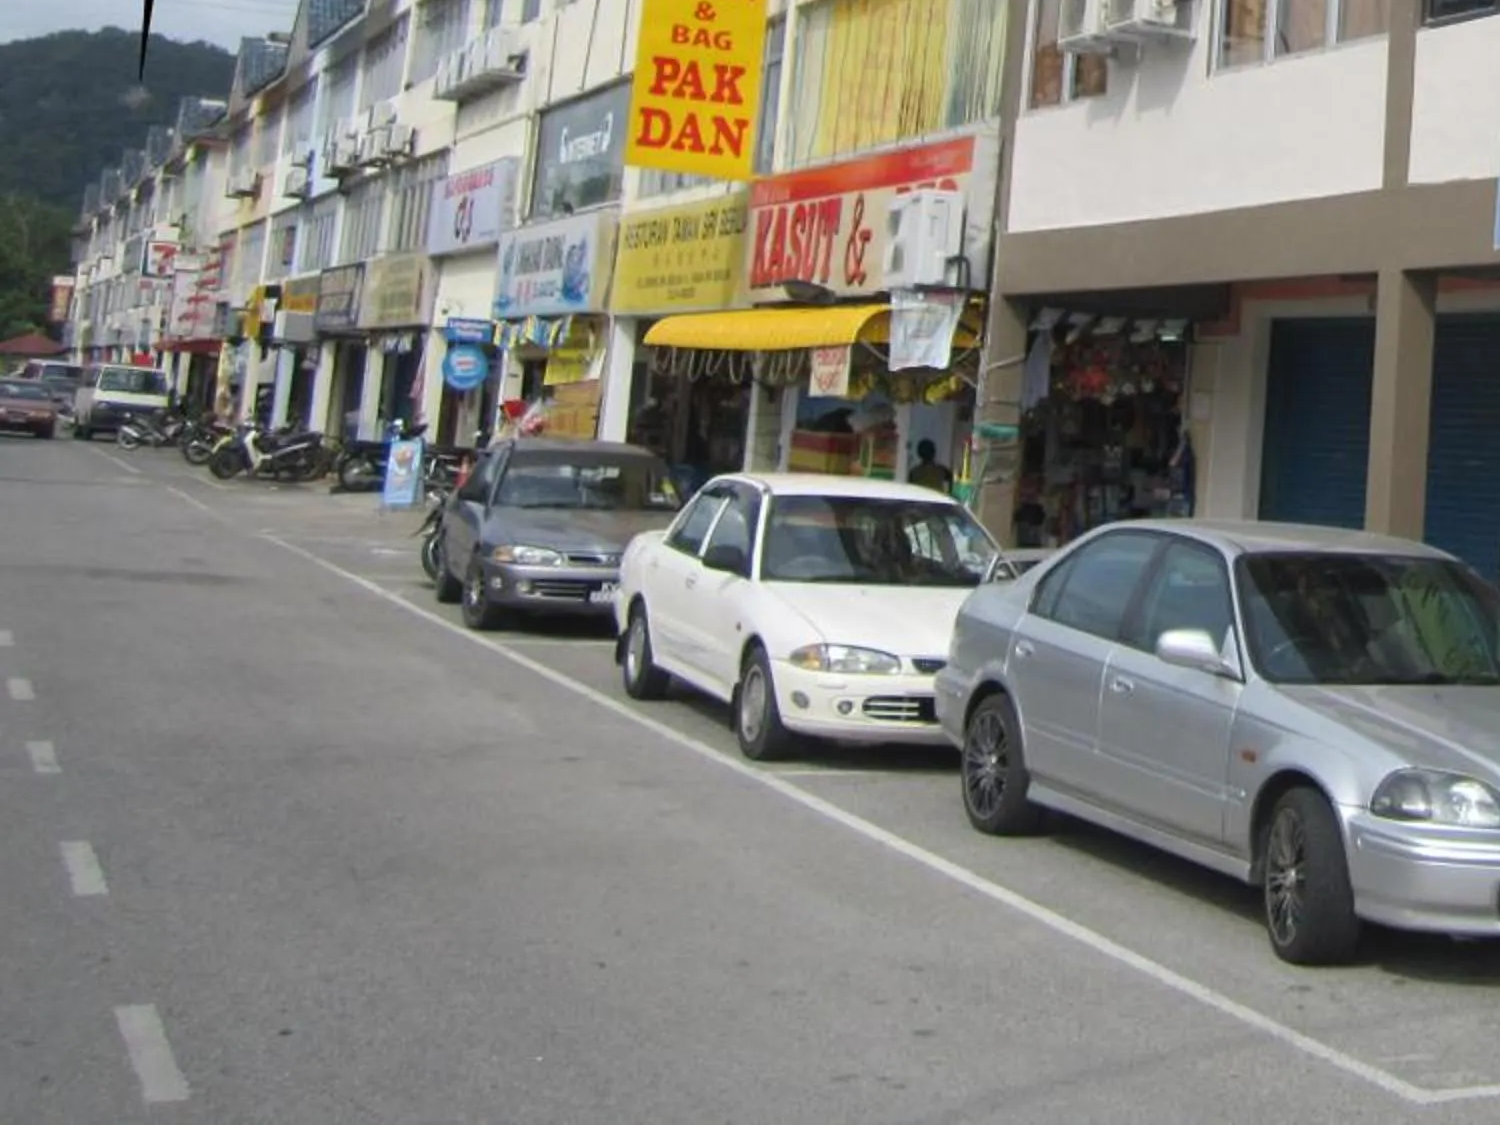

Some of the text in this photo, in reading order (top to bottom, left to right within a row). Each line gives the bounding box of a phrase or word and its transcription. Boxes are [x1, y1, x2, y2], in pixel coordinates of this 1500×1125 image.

[694, 0, 716, 22] &
[671, 23, 733, 50] BAG
[648, 56, 747, 105] PAK
[636, 106, 749, 158] DAN
[749, 192, 872, 289] KASUT &
